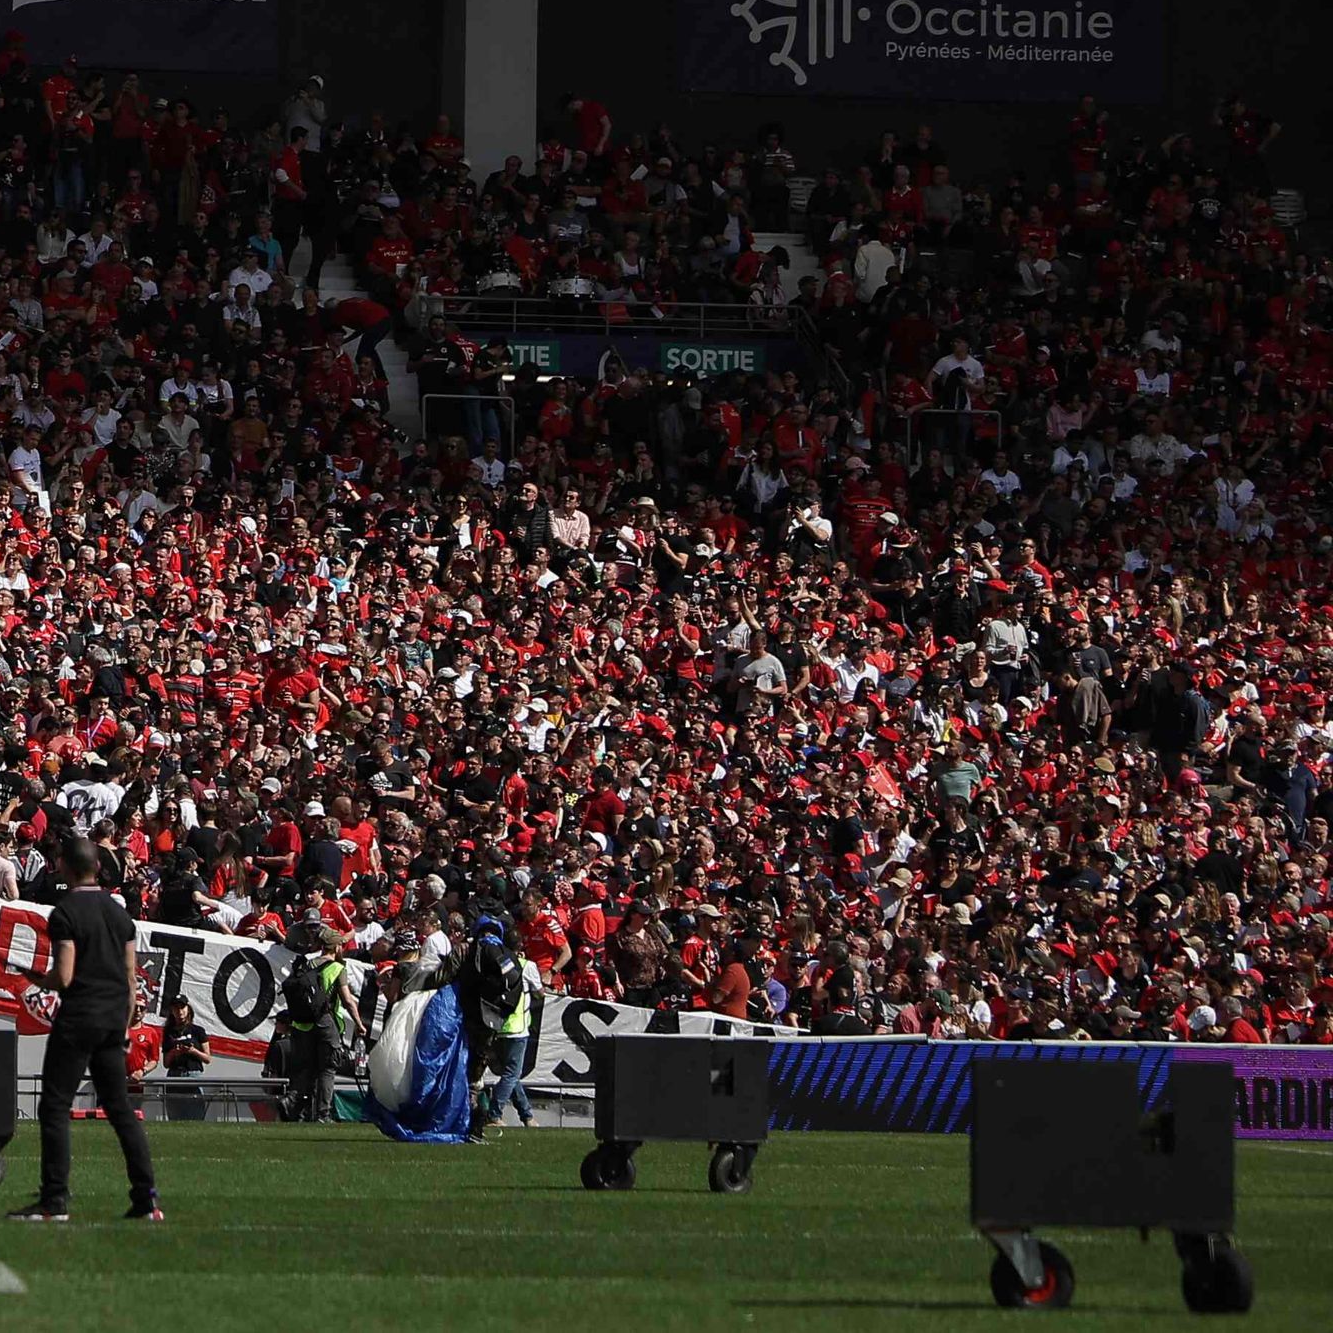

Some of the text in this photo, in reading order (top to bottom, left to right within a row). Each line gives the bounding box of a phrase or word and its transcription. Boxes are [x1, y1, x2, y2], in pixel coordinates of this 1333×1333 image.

[885, 41, 971, 64] Pyrénées
[987, 42, 1114, 64] Méditerranée
[666, 347, 756, 372] SORTIE
